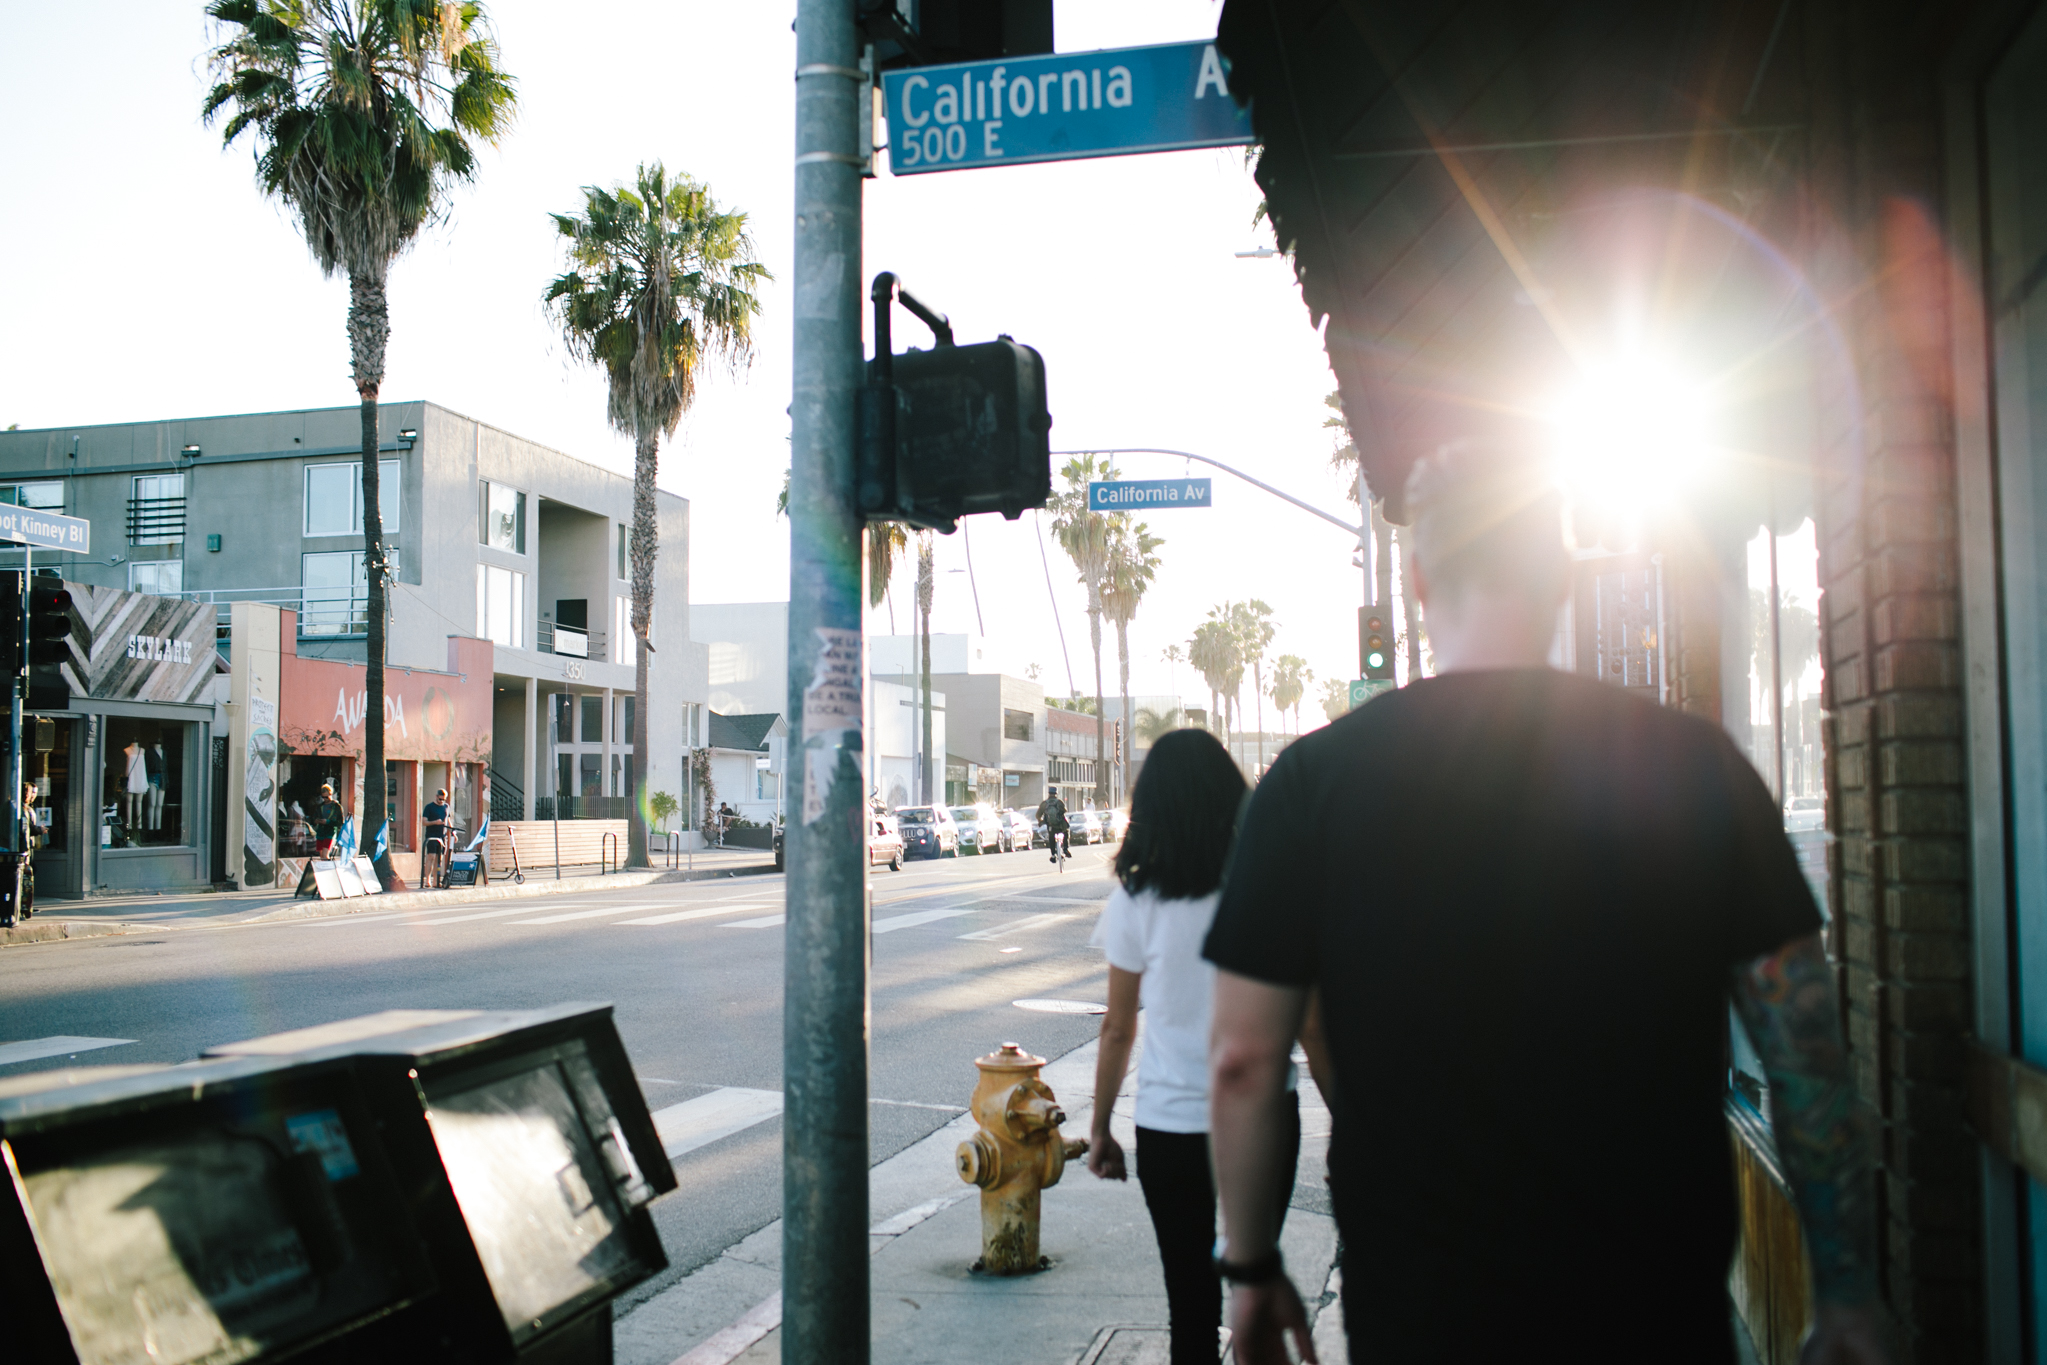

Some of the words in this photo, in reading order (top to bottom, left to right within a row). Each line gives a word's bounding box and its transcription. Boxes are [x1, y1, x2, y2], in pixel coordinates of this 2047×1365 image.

[902, 65, 1133, 128] California
[1194, 44, 1229, 99] A
[902, 124, 967, 166] 500
[984, 119, 1004, 157] E
[1096, 485, 1178, 504] California
[1184, 484, 1205, 500] Av
[0, 513, 17, 531] ot
[21, 515, 66, 544] Kinney
[127, 633, 193, 665] SKYLARK
